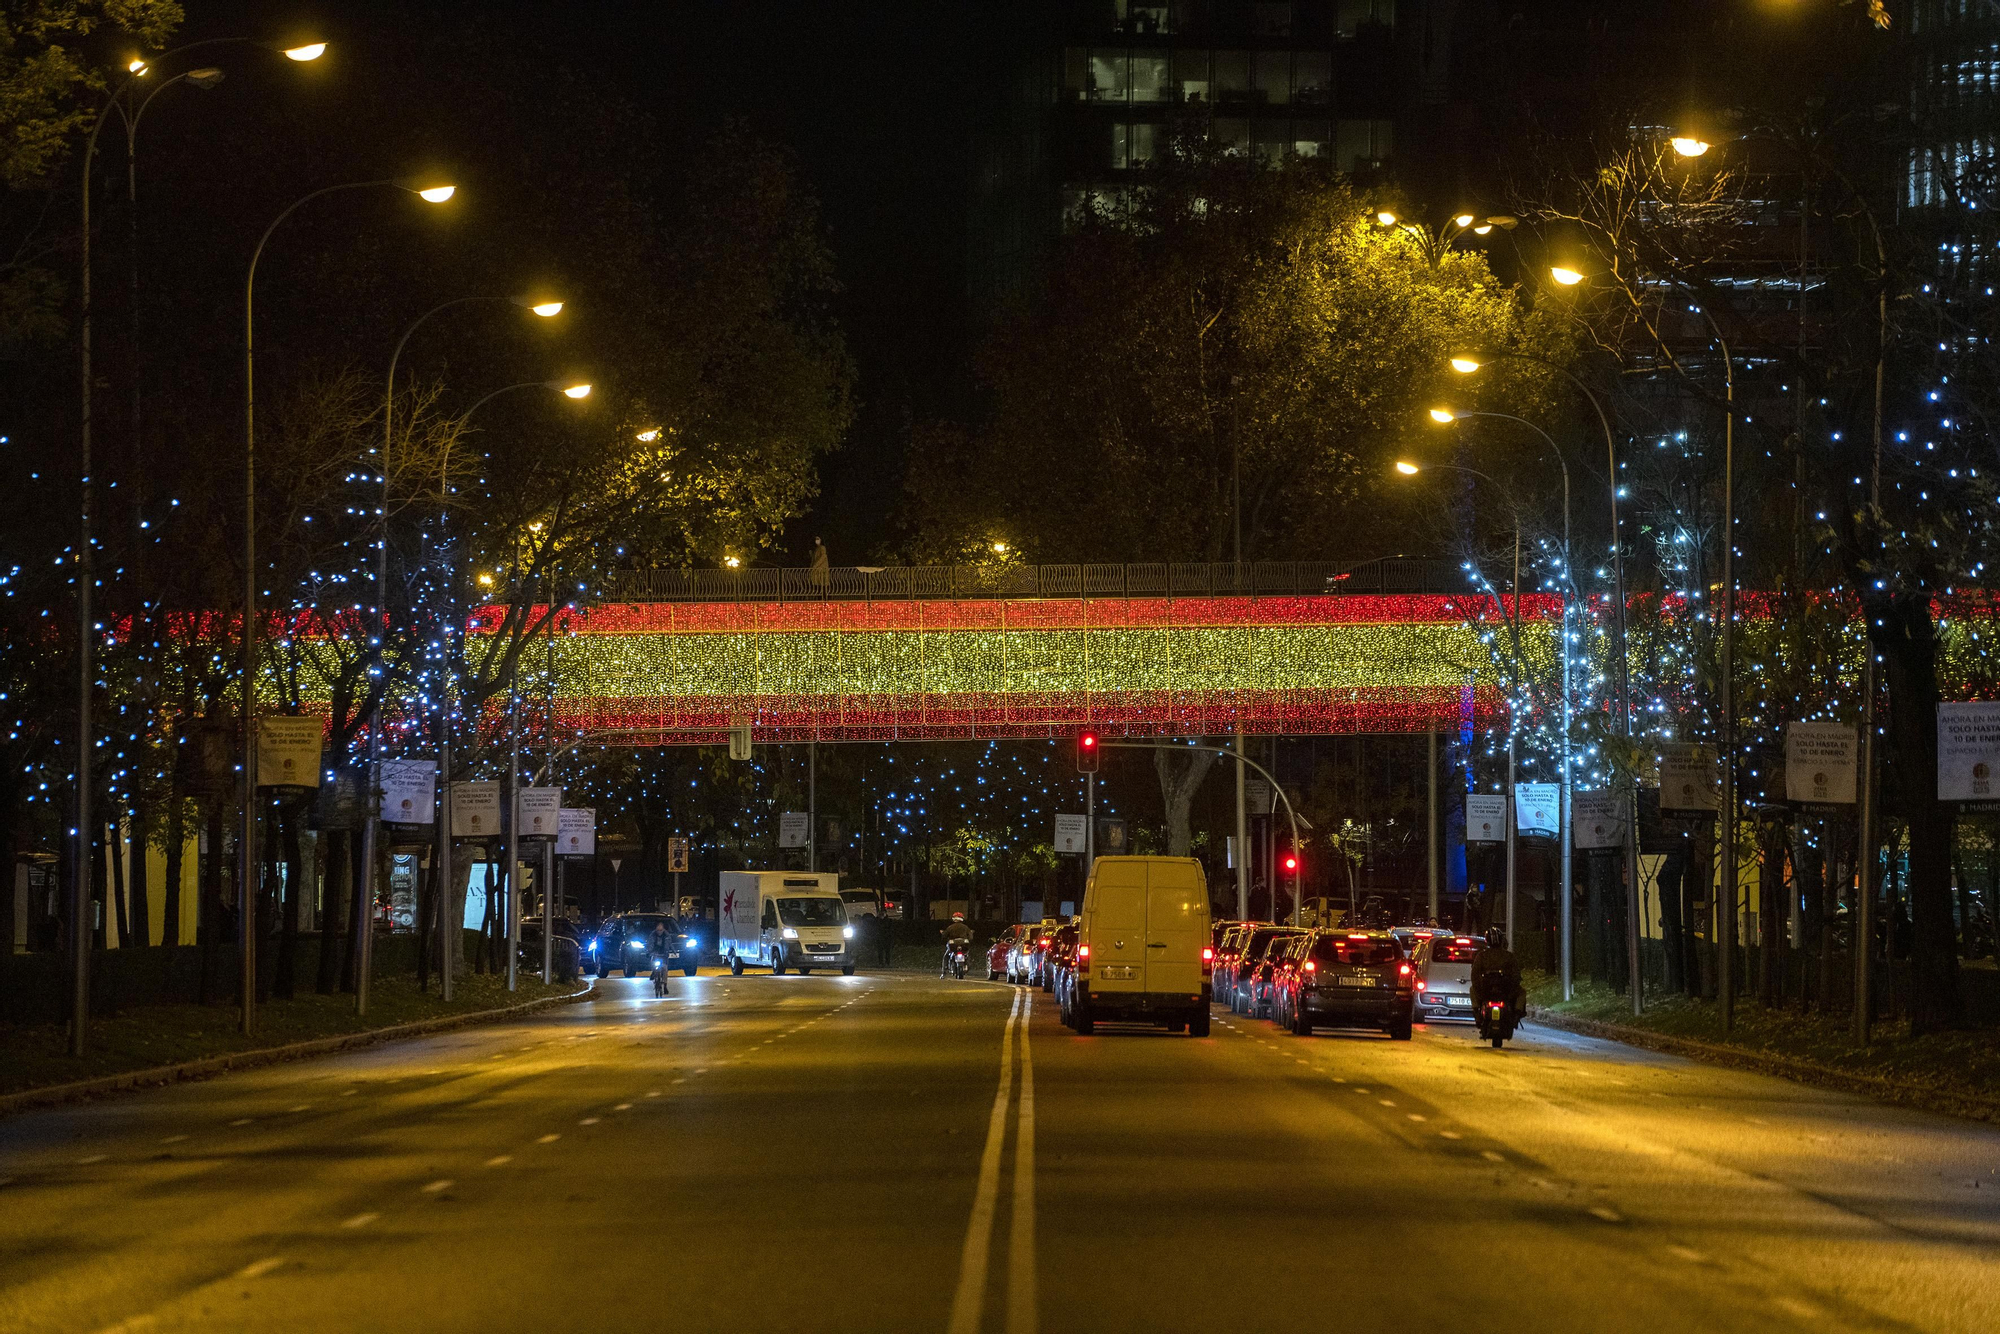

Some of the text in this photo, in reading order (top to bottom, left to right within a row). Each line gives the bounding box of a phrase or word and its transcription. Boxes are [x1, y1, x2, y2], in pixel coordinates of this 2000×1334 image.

[1942, 715, 1971, 723] AHORA
[1974, 714, 1985, 723] EN
[1949, 725, 1971, 733] SOLO
